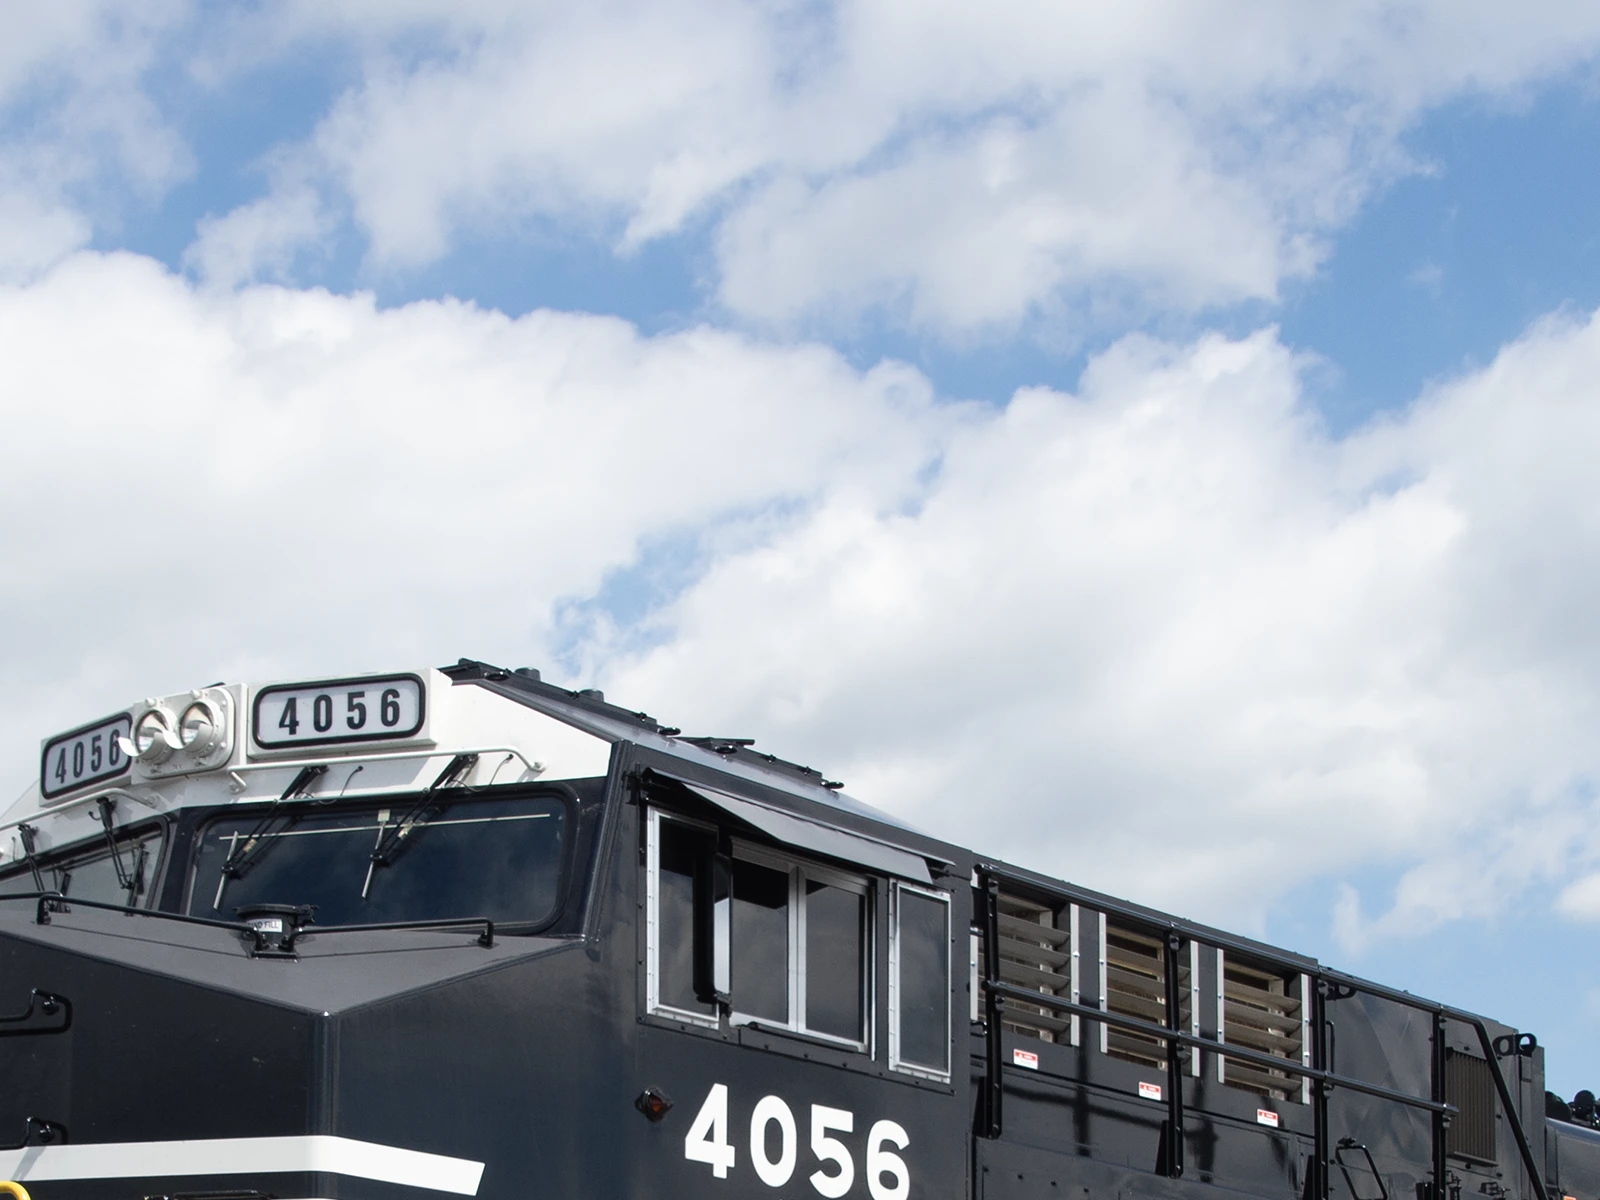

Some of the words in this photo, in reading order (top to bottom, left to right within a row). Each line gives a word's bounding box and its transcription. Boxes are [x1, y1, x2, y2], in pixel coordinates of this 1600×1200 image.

[278, 687, 401, 736] 4056
[54, 728, 121, 784] 4056
[264, 920, 279, 929] FILL
